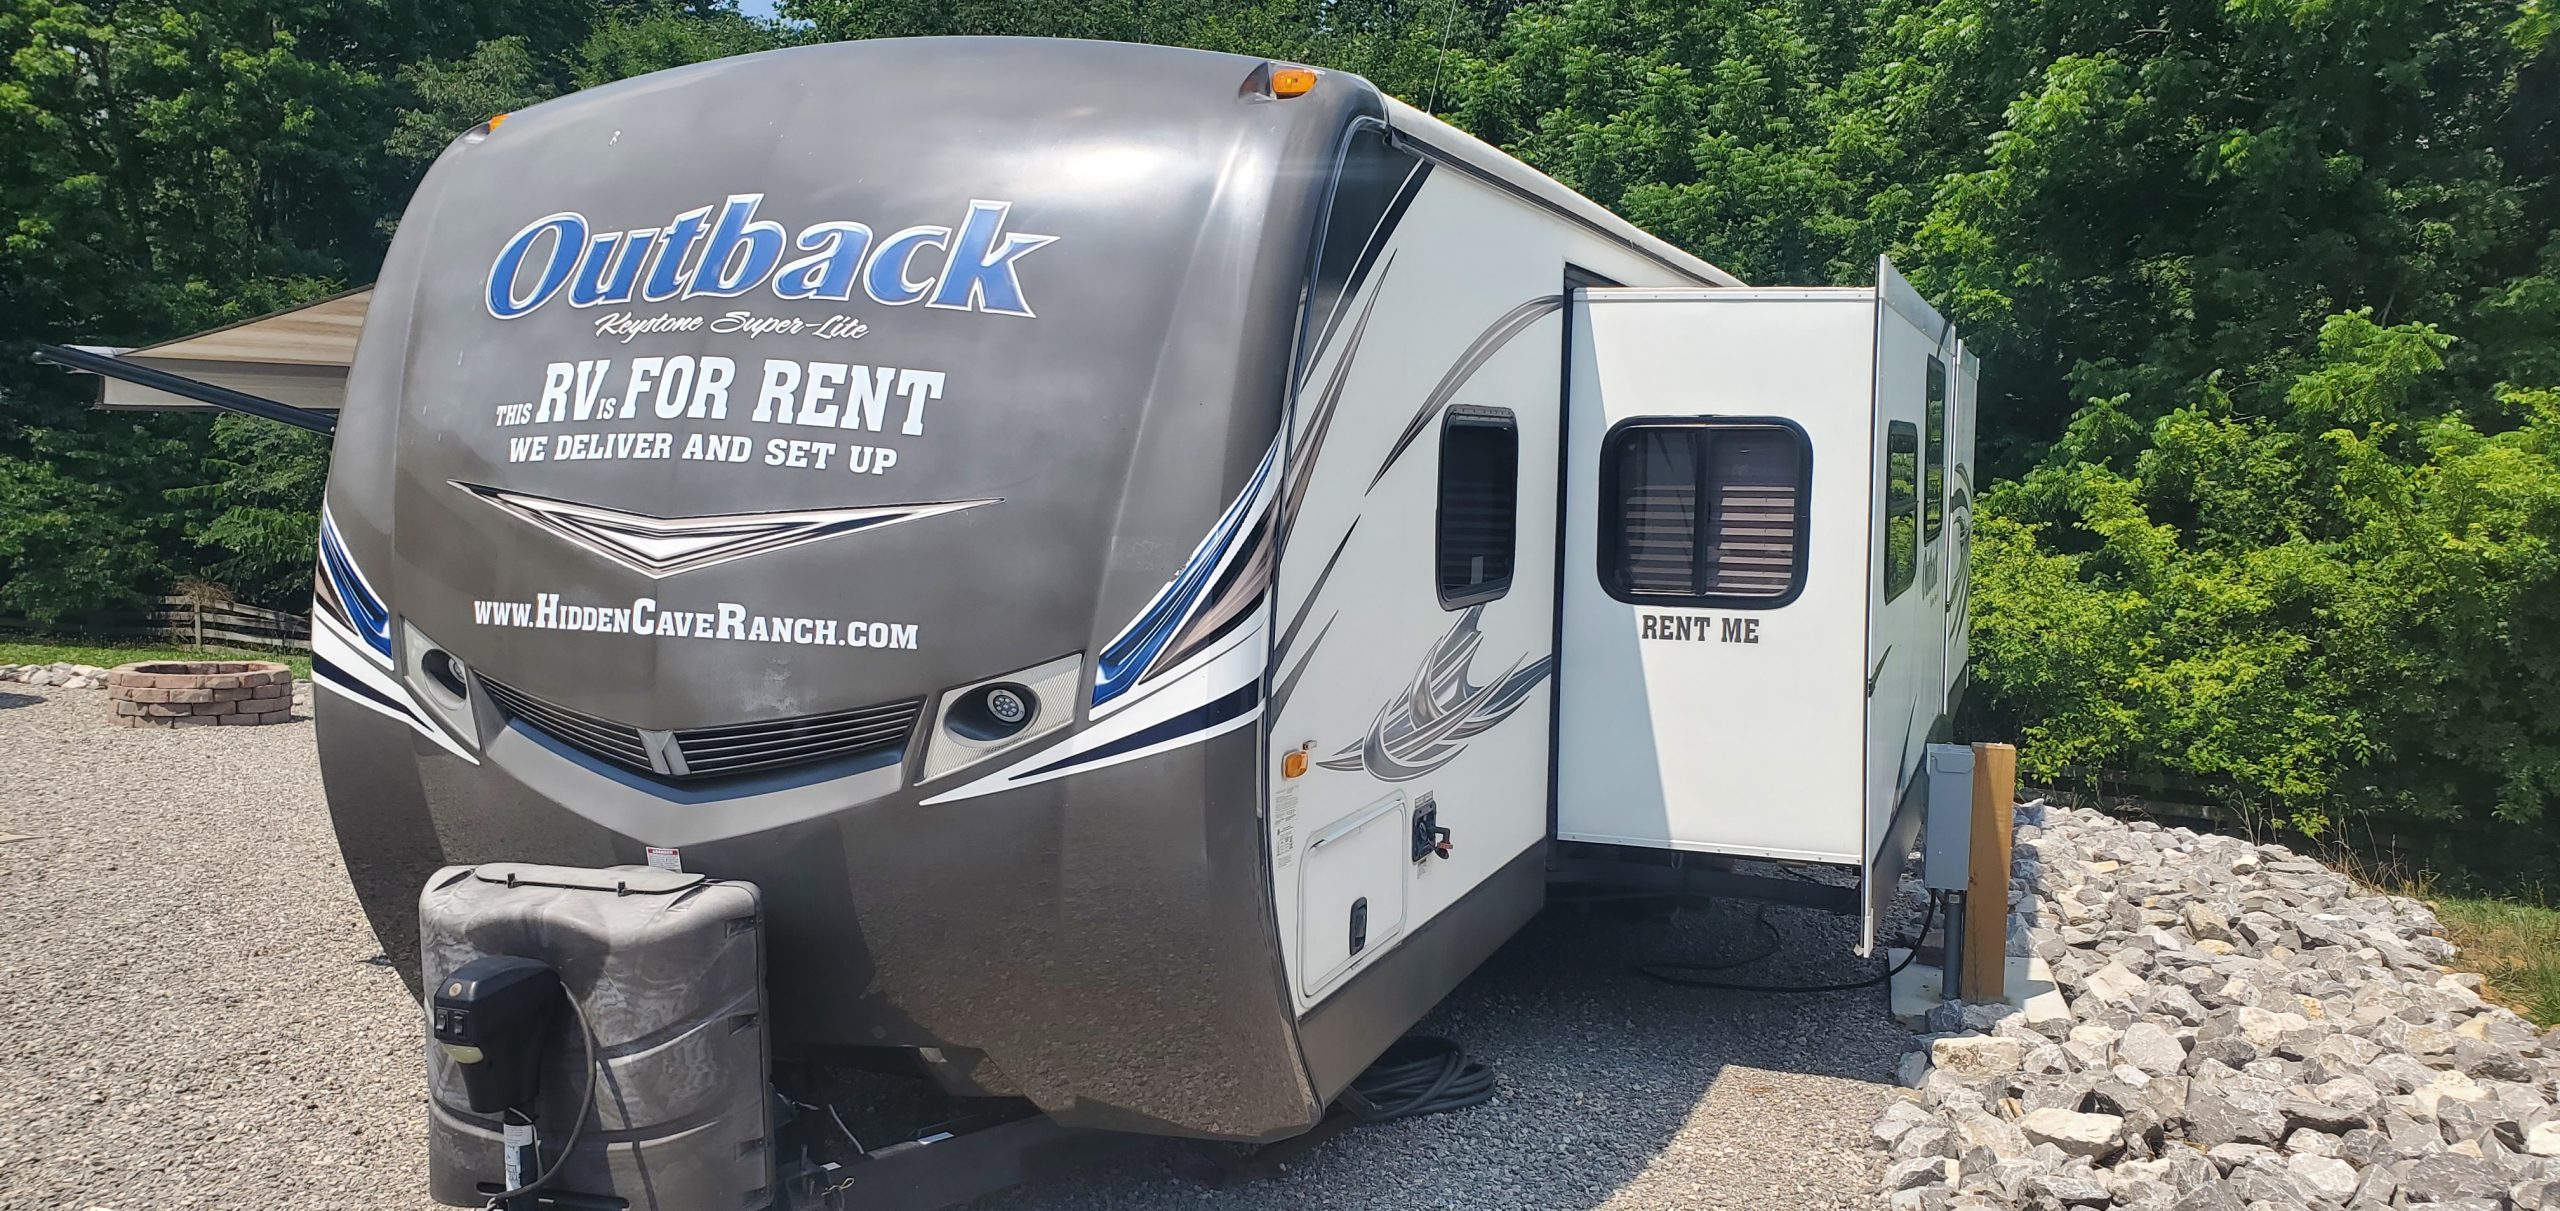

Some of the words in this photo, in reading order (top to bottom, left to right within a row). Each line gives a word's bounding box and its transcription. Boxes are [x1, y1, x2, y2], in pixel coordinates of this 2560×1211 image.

[485, 193, 1061, 318] Outback
[594, 311, 705, 343] Keystone
[709, 311, 869, 340] Super-Lite
[496, 403, 533, 428] THIS
[534, 359, 612, 424] RV
[596, 397, 617, 421] IS
[619, 355, 737, 421] FOR
[752, 359, 947, 437] RENT
[509, 436, 545, 463] WE
[553, 431, 672, 462] DELIVER
[682, 434, 753, 463] AND
[764, 439, 837, 470] SET
[849, 446, 898, 476] UP
[1641, 614, 1711, 642] RENT
[1720, 617, 1761, 644] ME
